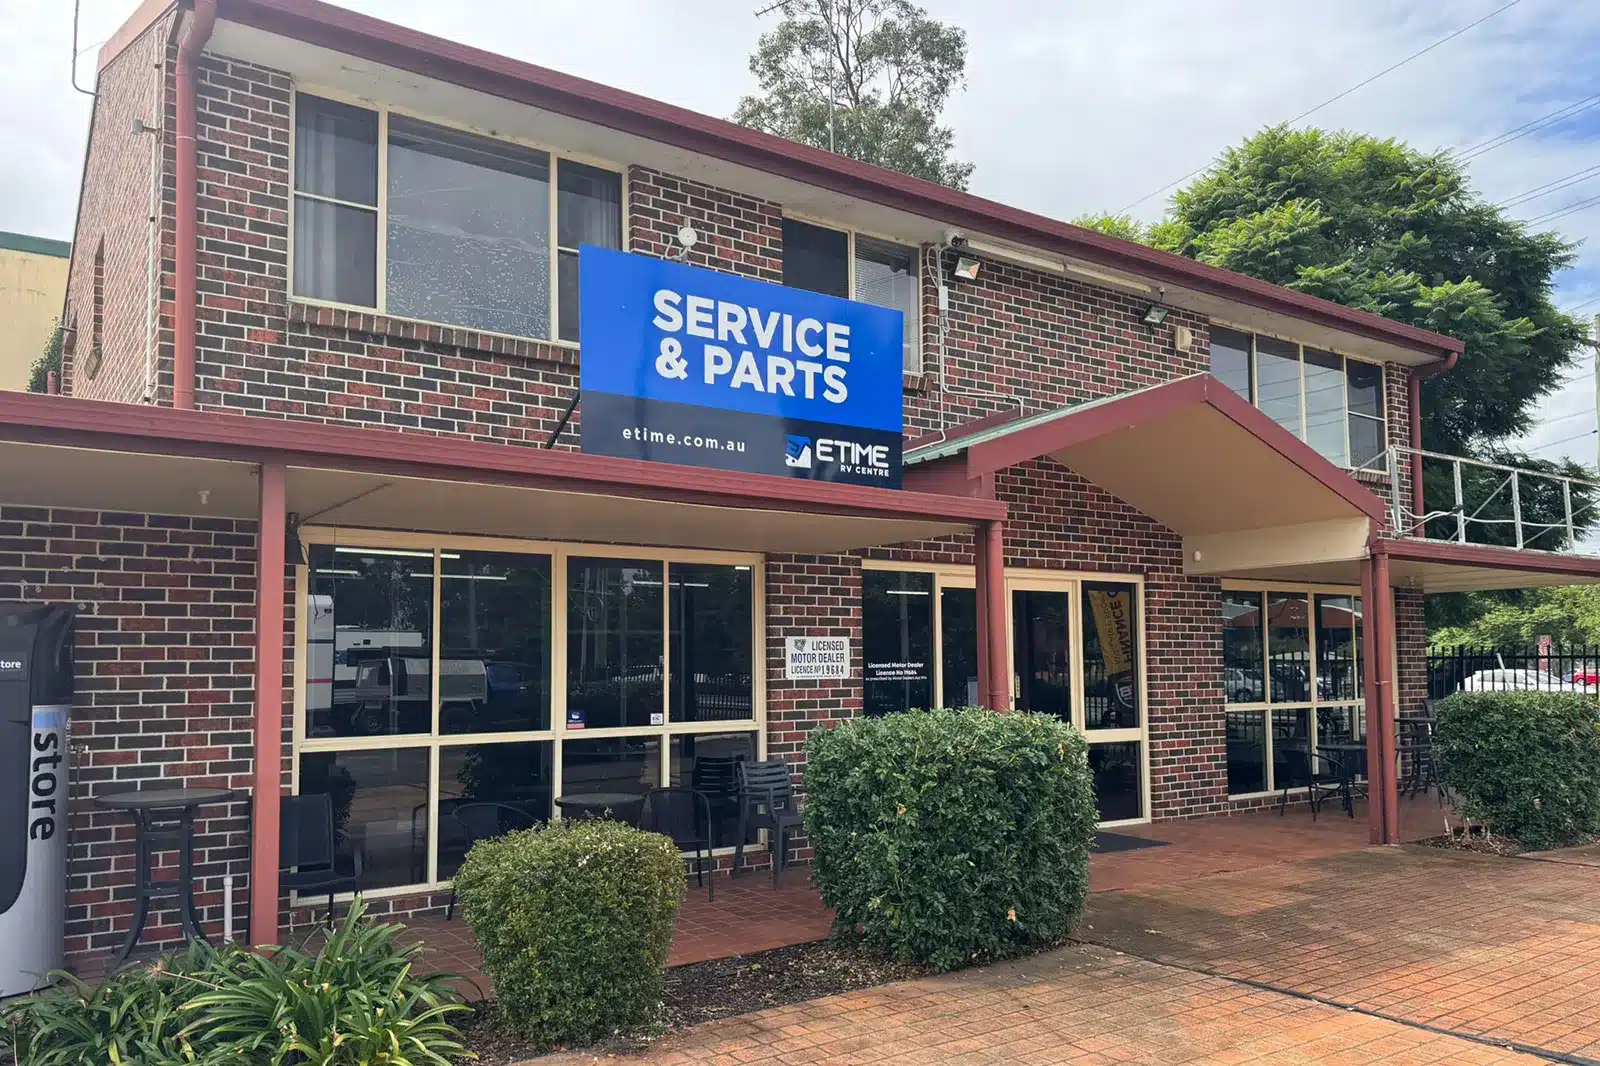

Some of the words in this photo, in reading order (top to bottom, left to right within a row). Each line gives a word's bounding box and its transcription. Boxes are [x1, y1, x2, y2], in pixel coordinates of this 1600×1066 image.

[652, 289, 851, 363] SERVICE
[655, 337, 688, 380] &
[704, 344, 848, 404] PARTS
[622, 427, 746, 453] etime.com.au
[816, 438, 890, 469] ETIME
[840, 464, 855, 474] RV
[855, 466, 890, 477] CENTRE
[811, 640, 845, 651] LICENSED
[0, 660, 22, 669] tore
[791, 653, 817, 664] MOTOR
[818, 653, 845, 663] DEALER
[868, 661, 891, 669] Licensed
[791, 665, 813, 674] LICENCE
[821, 664, 844, 675] 19684
[29, 731, 63, 841] store
